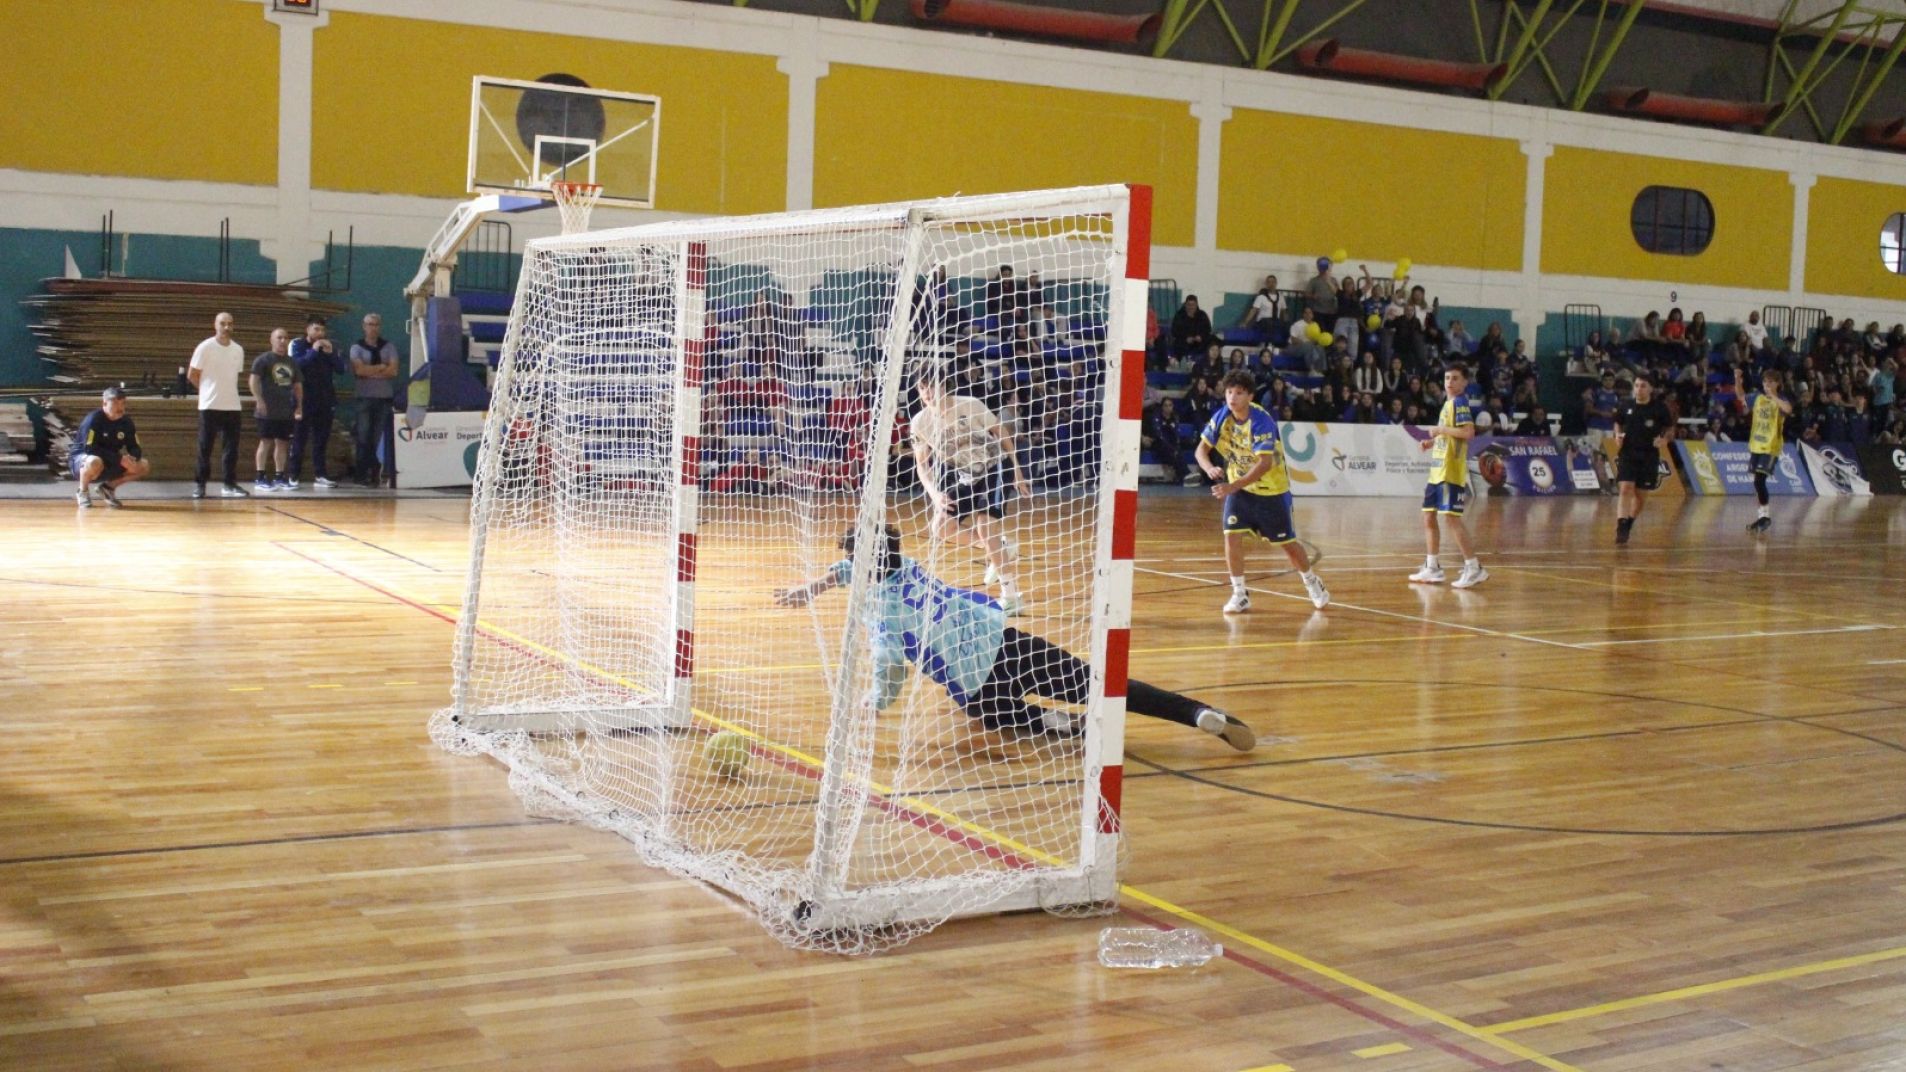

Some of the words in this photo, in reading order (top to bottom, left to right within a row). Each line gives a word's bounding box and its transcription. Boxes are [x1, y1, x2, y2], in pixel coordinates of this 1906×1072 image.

[416, 431, 448, 440] Alvear
[456, 432, 483, 441] Deport
[1509, 446, 1527, 456] SAN
[1529, 446, 1558, 456] RAFAEL
[1348, 461, 1377, 470] ALVEAR
[1532, 467, 1546, 477] 25
